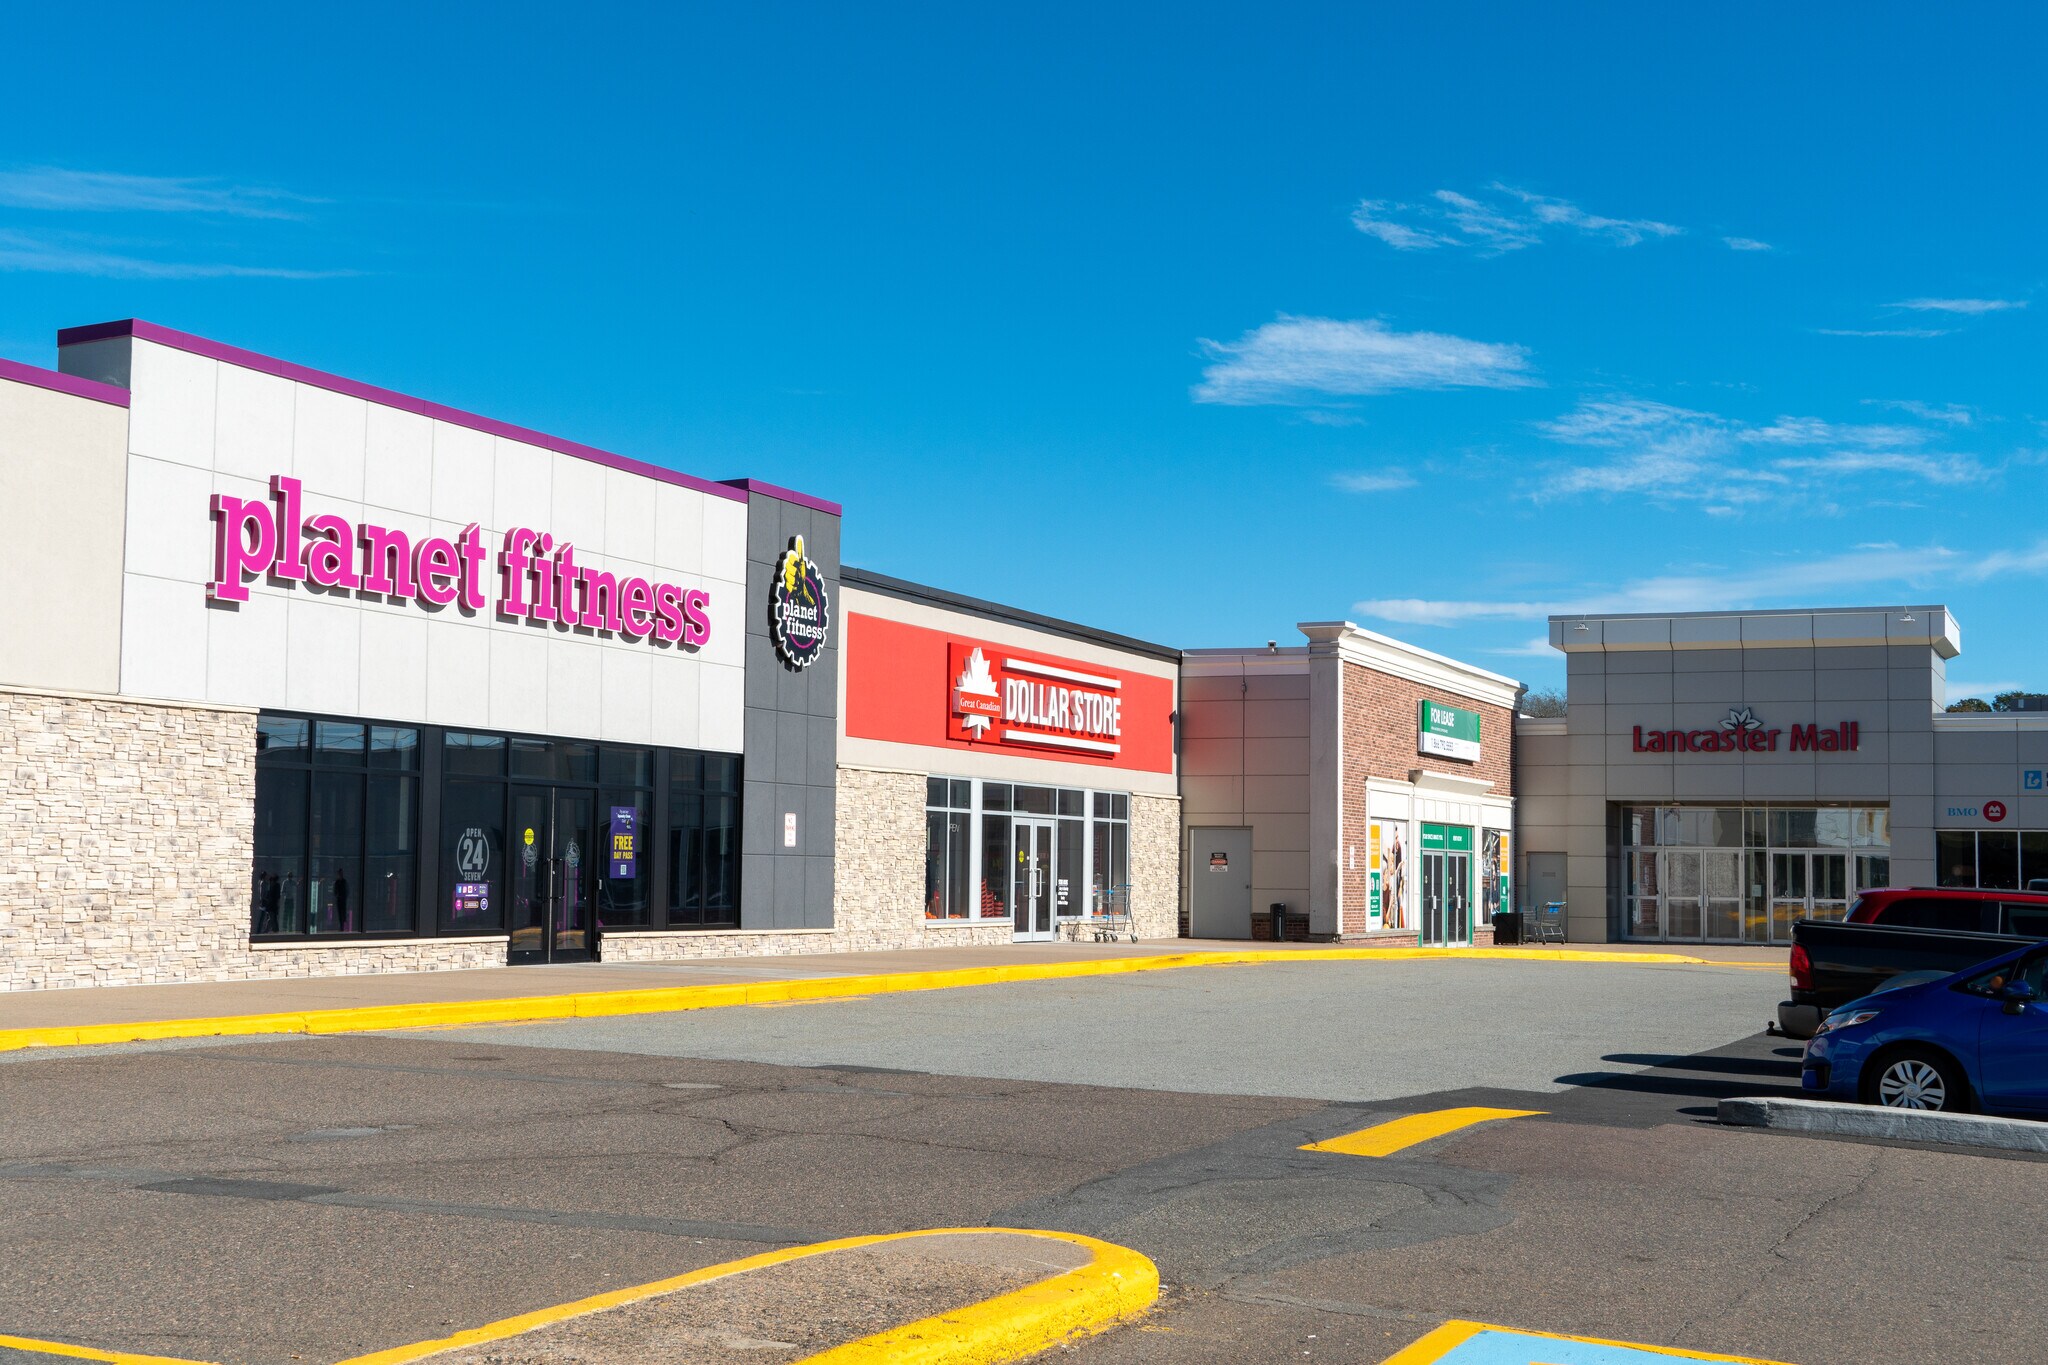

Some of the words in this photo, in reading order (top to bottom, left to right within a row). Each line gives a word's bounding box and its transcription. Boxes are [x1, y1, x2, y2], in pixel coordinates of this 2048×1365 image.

[207, 475, 487, 611] planet
[499, 527, 711, 647] fitness
[782, 599, 817, 621] planet
[786, 616, 822, 640] fitness
[960, 697, 975, 709] Great
[976, 699, 1001, 712] Canadian
[1001, 678, 1069, 729] DOLLAR
[1071, 690, 1121, 736] STORE
[1431, 708, 1440, 723] FOR
[1441, 710, 1454, 727] LEASE
[1632, 724, 1781, 753] Lancaster
[1789, 721, 1859, 752] Mall
[1947, 807, 1978, 817] BMO
[466, 828, 482, 837] OPEN
[614, 836, 633, 850] FREE
[462, 838, 483, 870] 24
[613, 851, 622, 860] DAY
[622, 851, 633, 860] PASS
[464, 872, 481, 881] SEVEN
